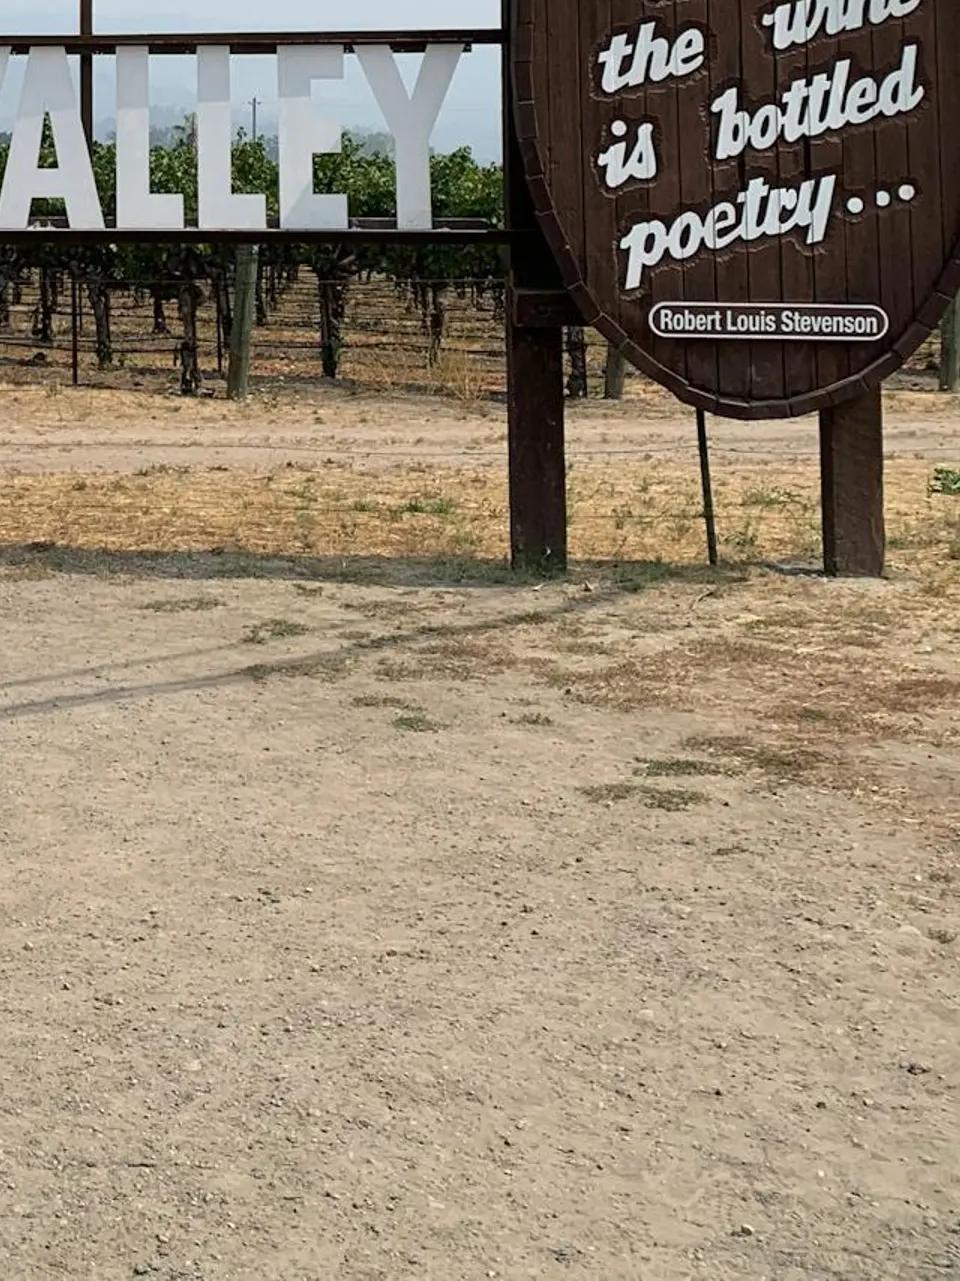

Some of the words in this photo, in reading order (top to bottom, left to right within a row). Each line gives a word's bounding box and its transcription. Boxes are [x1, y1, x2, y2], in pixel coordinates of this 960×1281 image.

[597, 22, 705, 94] the
[597, 120, 657, 188] is
[710, 45, 925, 160] bottled
[659, 309, 721, 332] Robert
[726, 310, 776, 332] Louis
[781, 311, 878, 334] Stevenson
